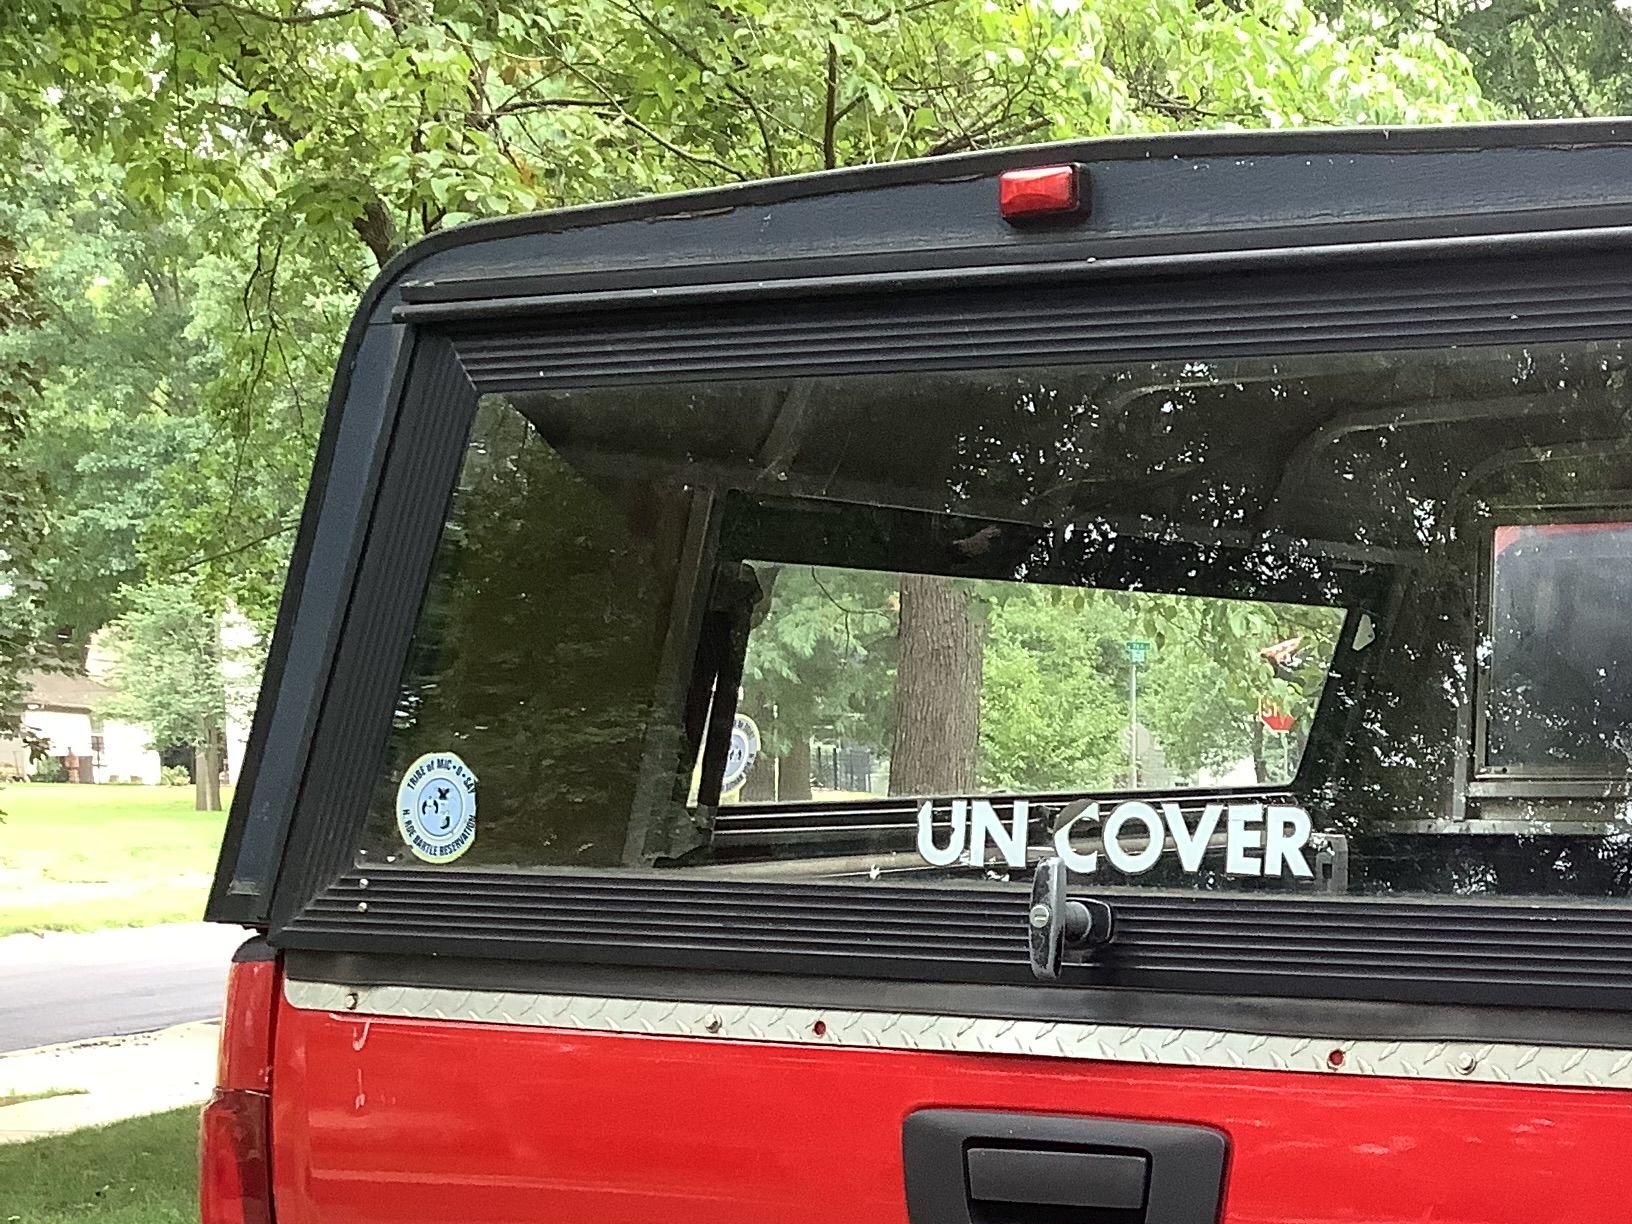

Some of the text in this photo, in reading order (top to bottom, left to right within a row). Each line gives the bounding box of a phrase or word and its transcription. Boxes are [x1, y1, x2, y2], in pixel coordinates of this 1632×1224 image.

[406, 765, 427, 790] TRIBE
[426, 760, 435, 772] of
[405, 820, 416, 837] ROE
[412, 835, 437, 856] BARTLE
[440, 814, 476, 856] RESERVATION
[918, 799, 1314, 879] UN COVER
